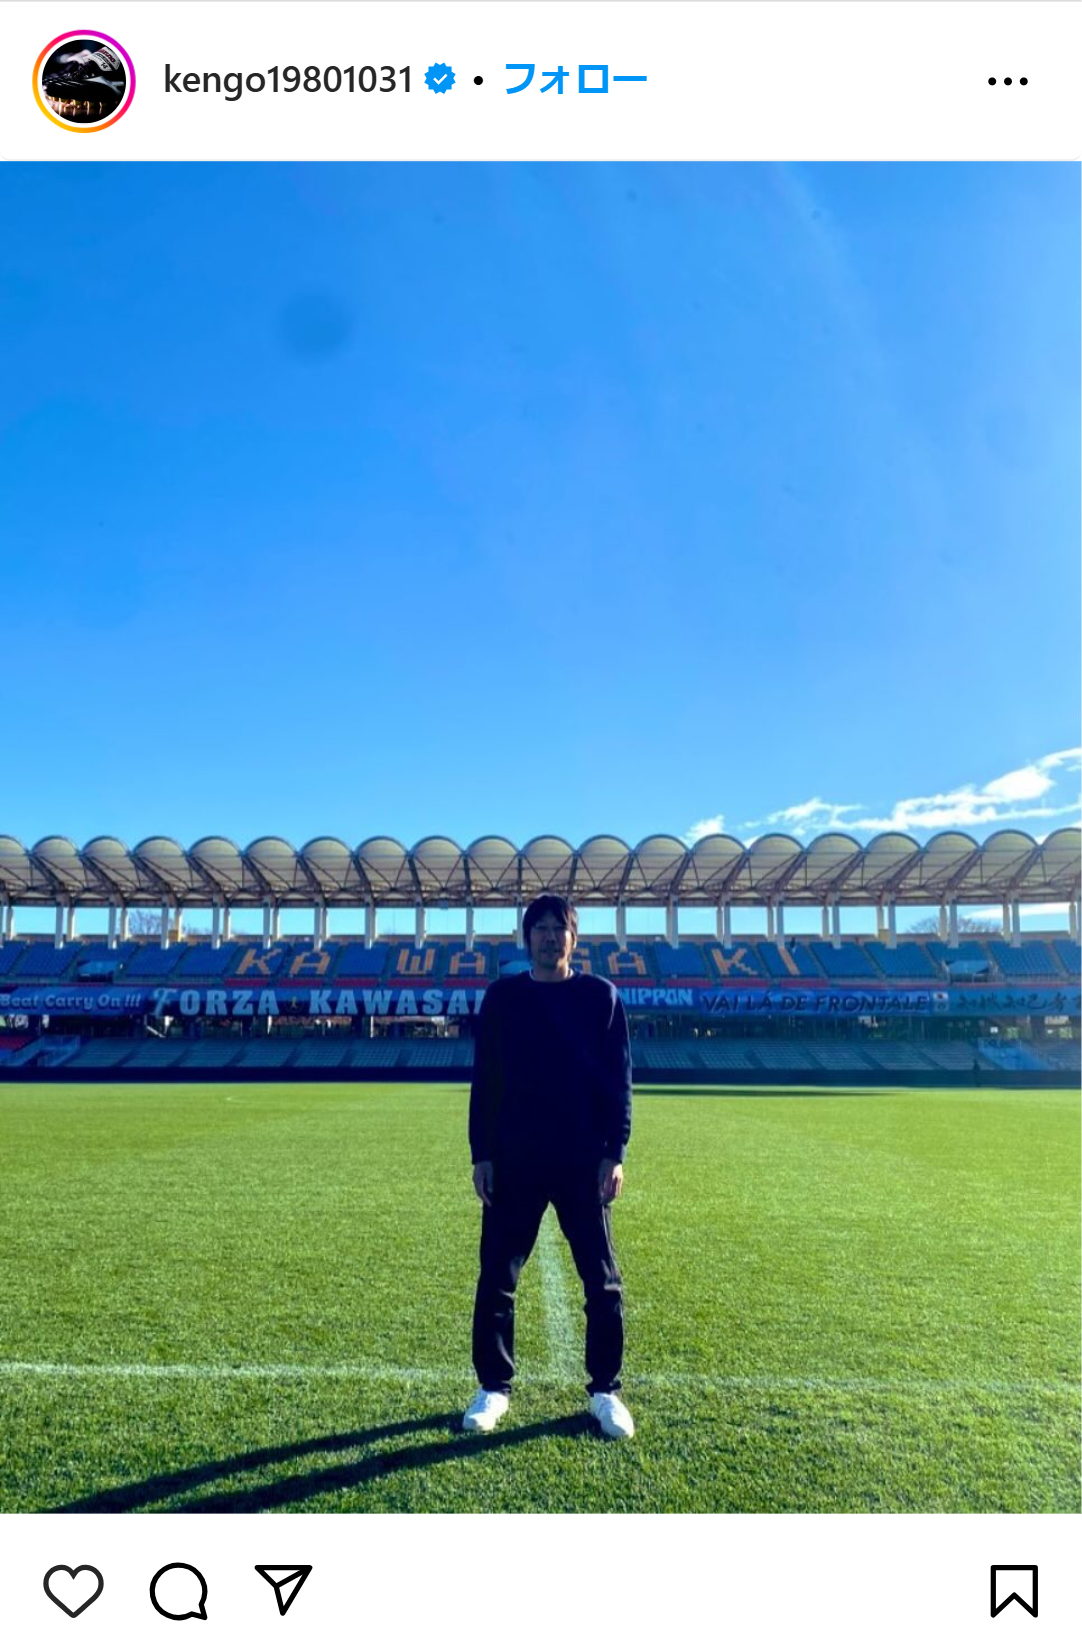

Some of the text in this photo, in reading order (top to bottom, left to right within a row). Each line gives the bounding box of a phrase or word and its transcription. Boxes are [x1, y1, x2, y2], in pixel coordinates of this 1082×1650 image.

[45, 993, 93, 1011] Carry
[98, 993, 121, 1008] On
[152, 987, 280, 1017] FORZA
[701, 993, 740, 1011] VAI
[780, 994, 807, 1011] DE
[815, 994, 928, 1012] FRONTALE
